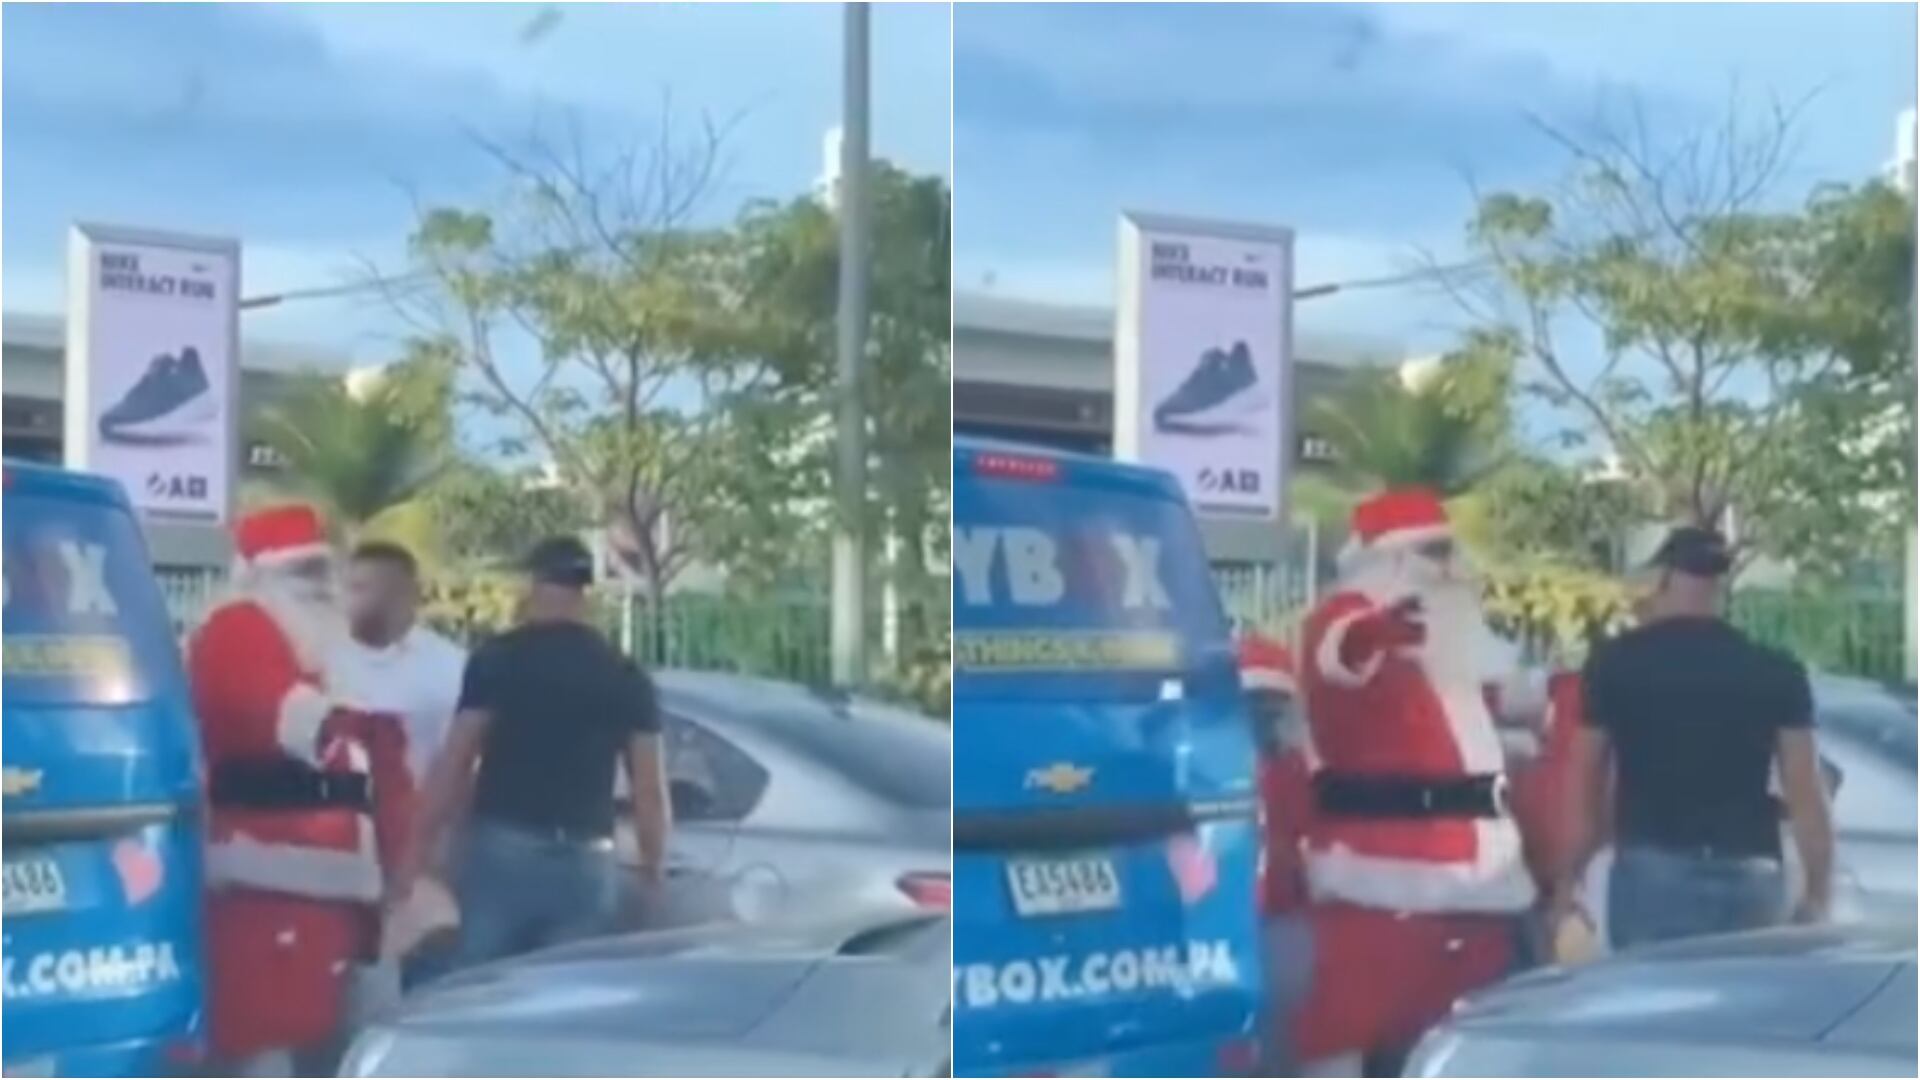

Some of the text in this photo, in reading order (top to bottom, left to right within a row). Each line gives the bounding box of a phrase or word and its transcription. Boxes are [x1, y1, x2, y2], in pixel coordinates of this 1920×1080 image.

[101, 272, 216, 299] INTERACT RUN
[1232, 266, 1269, 290] RUN
[953, 939, 1238, 1007] BOX.COM.PA
